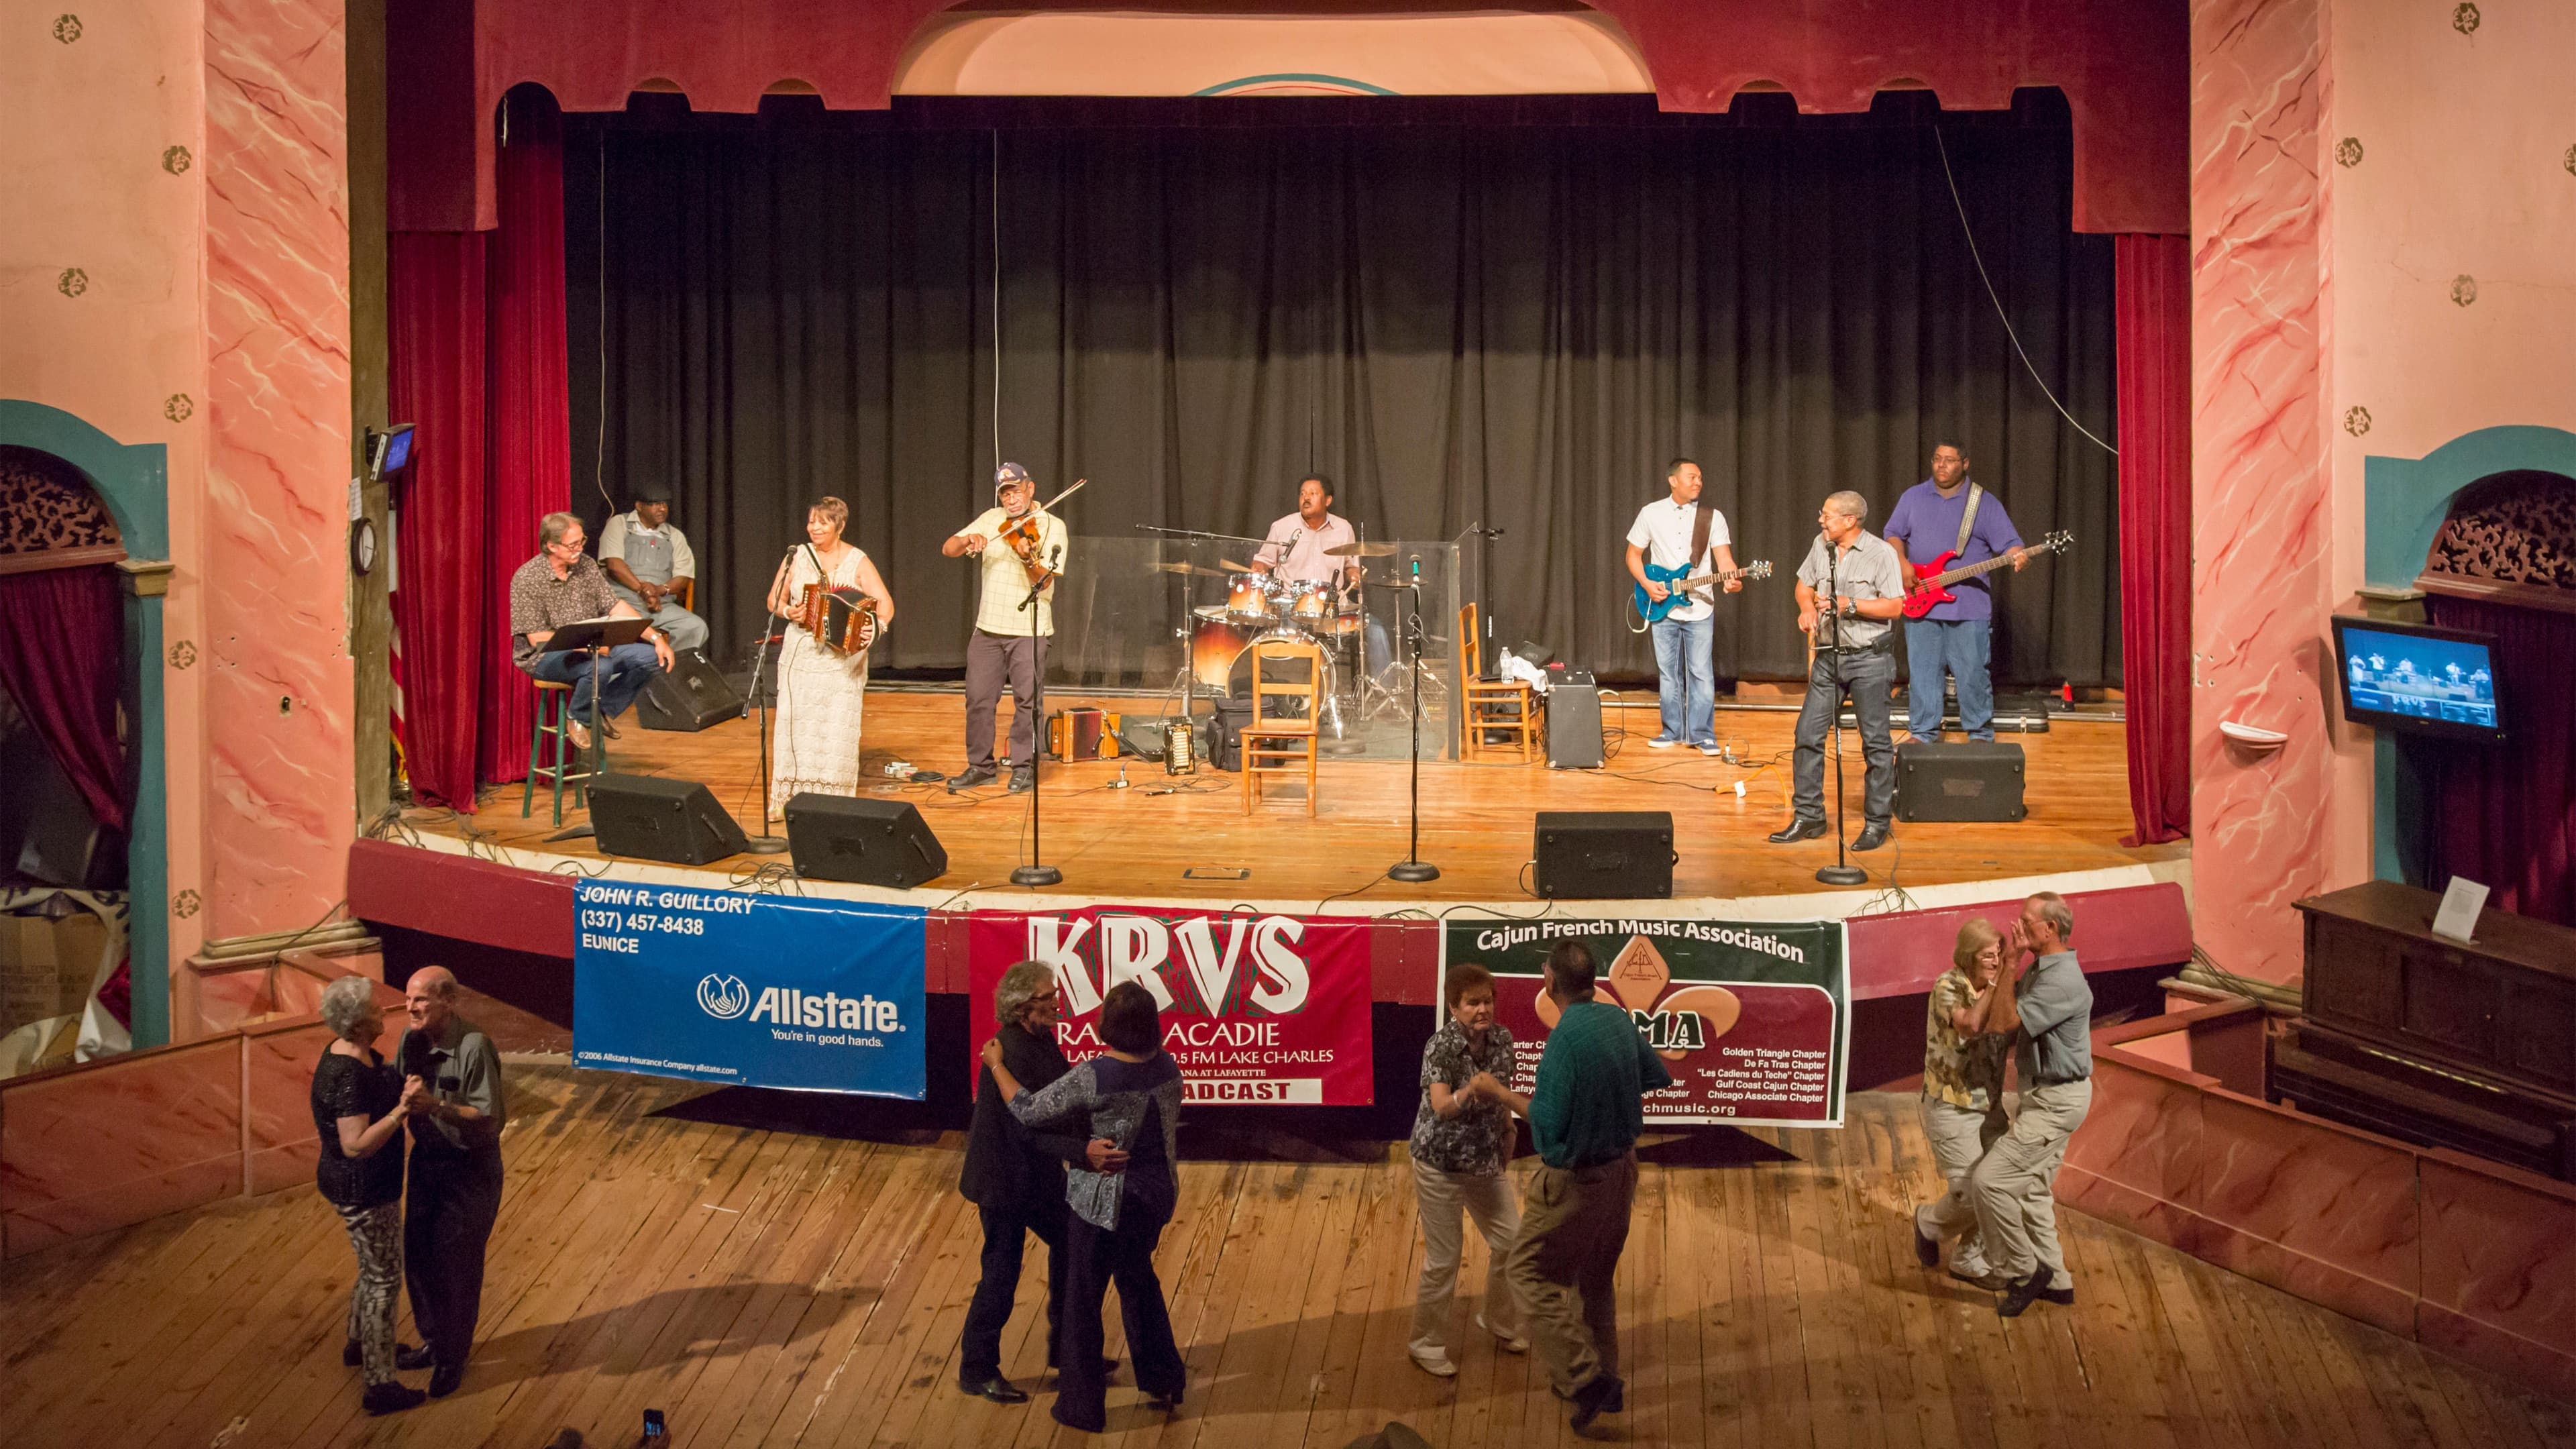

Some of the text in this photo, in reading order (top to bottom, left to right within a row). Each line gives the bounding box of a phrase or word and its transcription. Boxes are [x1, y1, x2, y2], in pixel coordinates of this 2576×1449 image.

[580, 886, 757, 914] JOHN R. GUILLORY
[582, 909, 704, 936] (337) 457-8438
[582, 933, 639, 954] EUNICE
[1477, 920, 1804, 963] Cajun French Music Association
[1028, 915, 1309, 1018] KRVS
[1162, 1022, 1281, 1046] ACADIE
[1621, 1008, 1705, 1049] MA
[771, 1028, 884, 1047] You're in good hands.
[1513, 1041, 1534, 1049] arter
[1192, 1051, 1216, 1064] FM
[1220, 1051, 1259, 1064] LAKE
[1263, 1049, 1334, 1064] CHARLES
[1515, 1051, 1543, 1062] Chapt
[1723, 1047, 1826, 1061] Golden Triangle Chapter
[603, 1053, 629, 1063] Allstate
[630, 1056, 662, 1067] Insurance
[663, 1059, 695, 1072] Company
[696, 1064, 737, 1075] allstate.com
[1744, 1059, 1825, 1071] De Fa Tras Chapter
[1717, 1069, 1750, 1079] Cadiens
[1752, 1070, 1762, 1079] du
[1793, 1071, 1825, 1082] Chapter
[1183, 1082, 1291, 1100] ADCAST
[1510, 1083, 1535, 1095] Lafay
[1656, 1089, 1690, 1099] Chapter
[1715, 1080, 1825, 1093] Gulf Coast Cajun Chapter
[1707, 1090, 1824, 1104] Chicago Associate Chapter
[1642, 1103, 1736, 1116] chmusic.org
